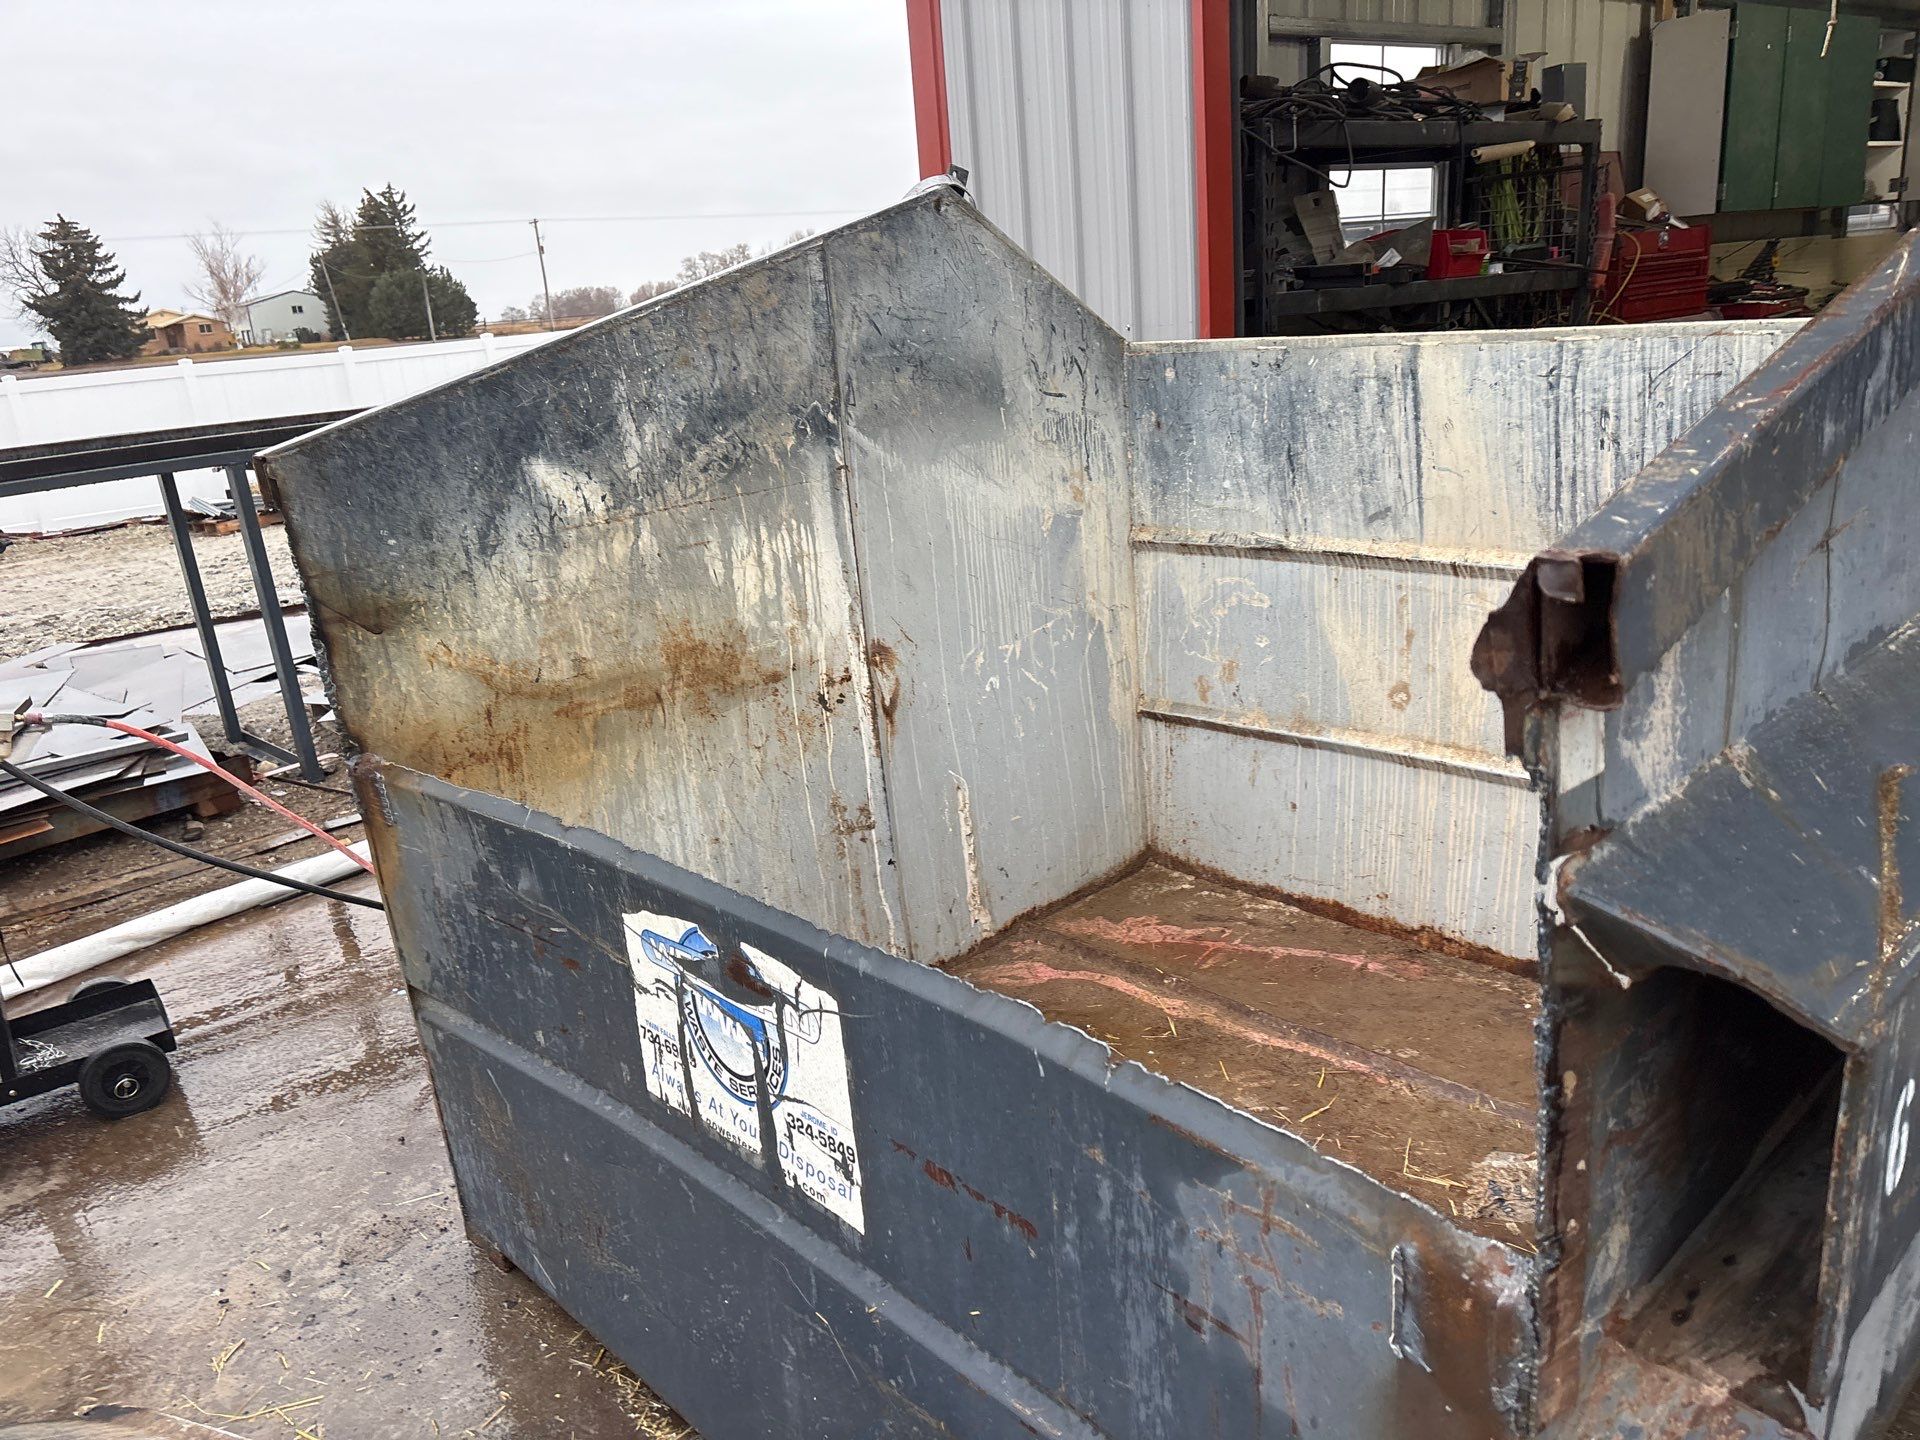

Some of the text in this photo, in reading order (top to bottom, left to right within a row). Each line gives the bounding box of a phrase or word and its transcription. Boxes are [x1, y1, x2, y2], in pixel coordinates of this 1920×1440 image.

[660, 1026, 677, 1042] FALLS
[684, 1001, 782, 1098] WASTE SERICES
[651, 1062, 853, 1202] Alwas At You Disposal
[830, 1125, 838, 1137] ID
